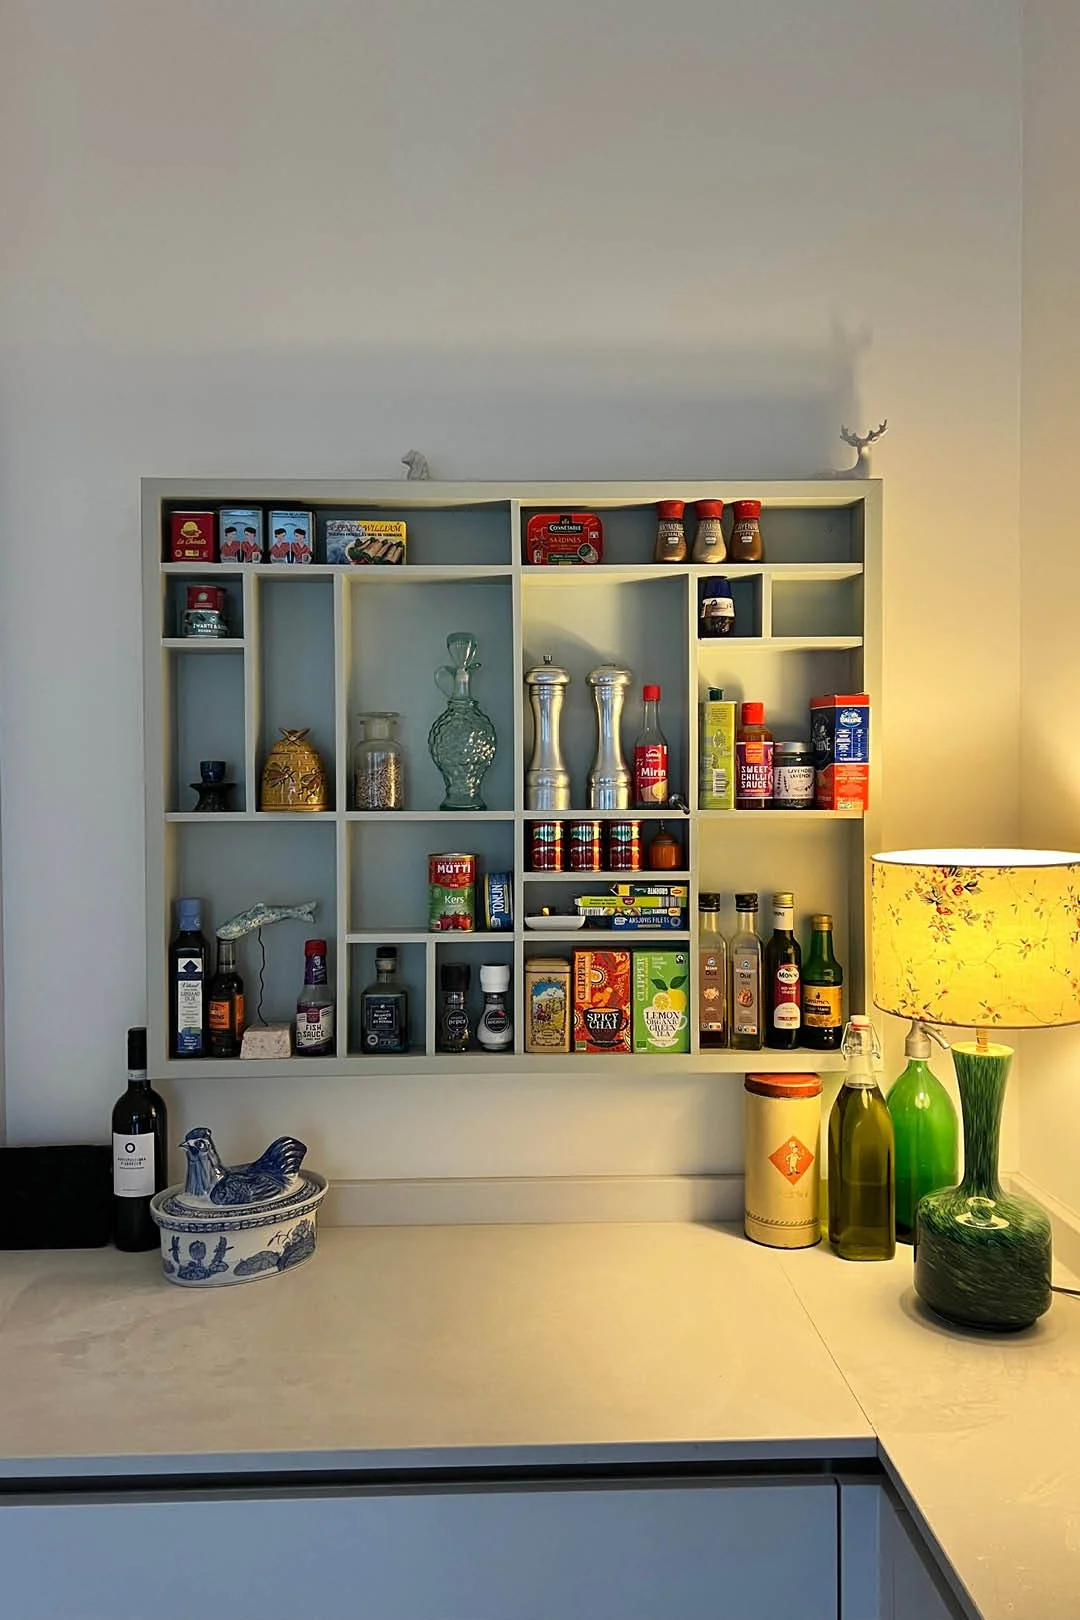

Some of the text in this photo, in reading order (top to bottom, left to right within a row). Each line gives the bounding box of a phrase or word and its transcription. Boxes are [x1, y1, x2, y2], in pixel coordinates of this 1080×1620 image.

[363, 522, 401, 533] WILLIAM
[641, 767, 666, 777] Mirin
[741, 765, 768, 773] SWEET
[741, 773, 767, 781] CHILLI
[437, 864, 471, 873] MUTTI
[444, 895, 464, 904] Kers
[577, 956, 586, 1000] CLIPPER
[636, 958, 645, 1001] CLIPPER
[586, 1013, 619, 1022] SPICY
[646, 1011, 680, 1020] LEMON
[589, 1021, 617, 1030] CHAI
[303, 1030, 325, 1038] SAUCE
